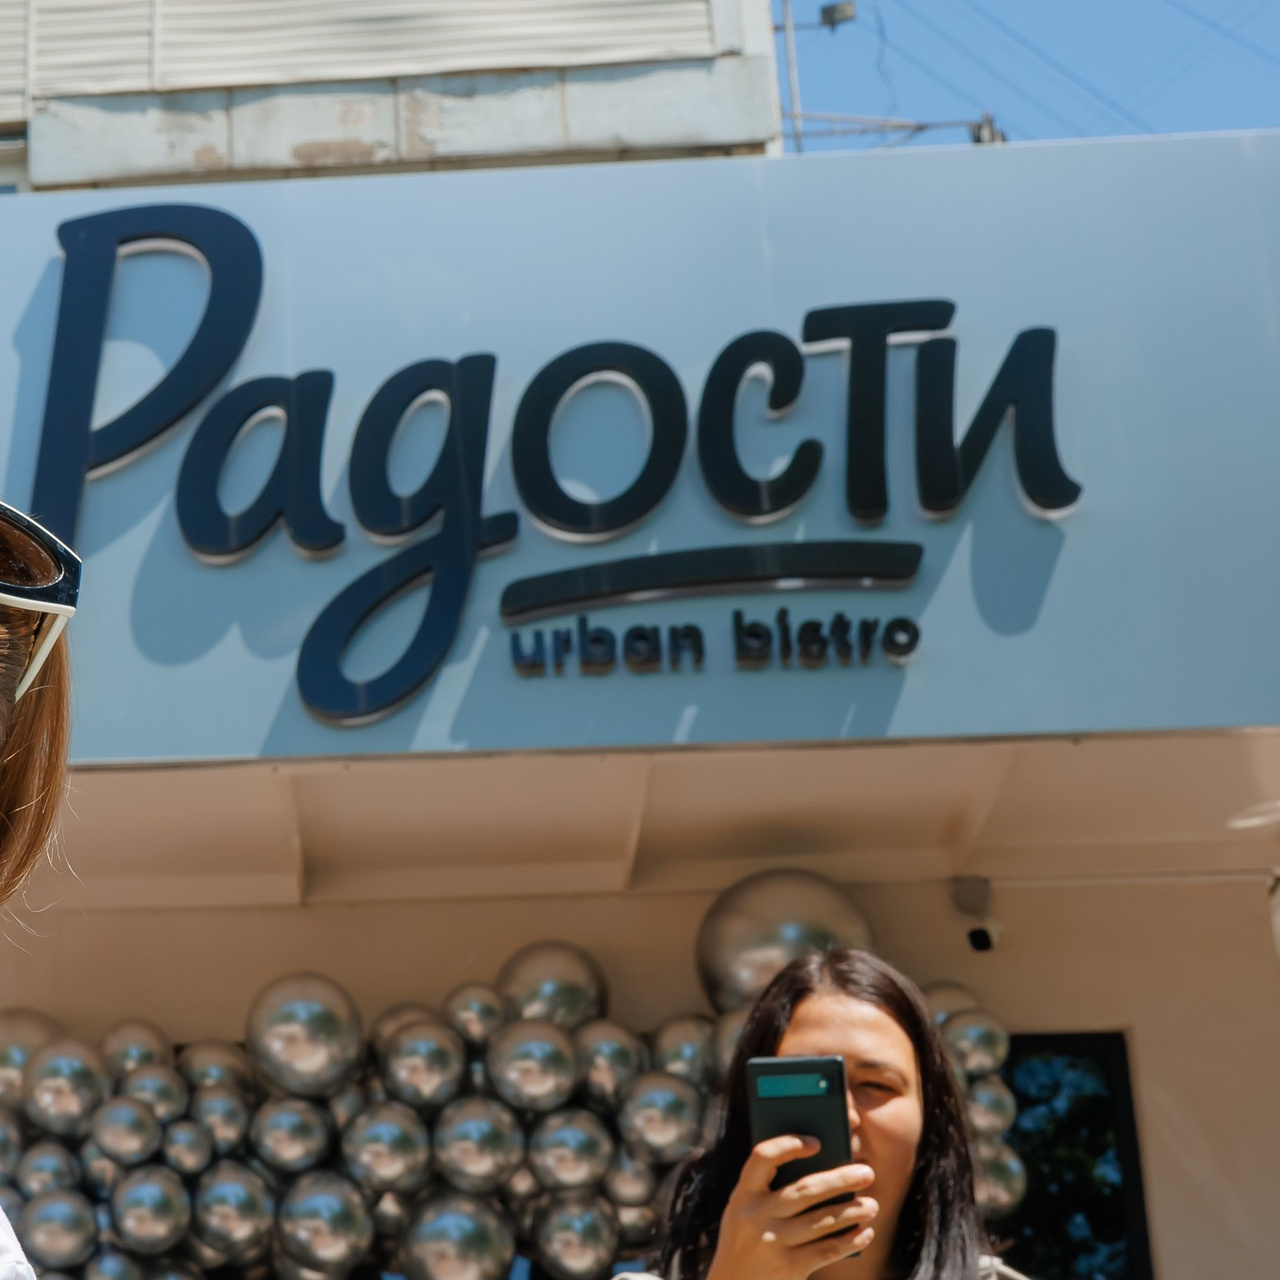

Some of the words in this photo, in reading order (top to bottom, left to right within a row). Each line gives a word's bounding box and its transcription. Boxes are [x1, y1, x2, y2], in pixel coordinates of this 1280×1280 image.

[32, 202, 1083, 726] Радости
[511, 614, 704, 677] urban
[733, 606, 922, 671] bistro
